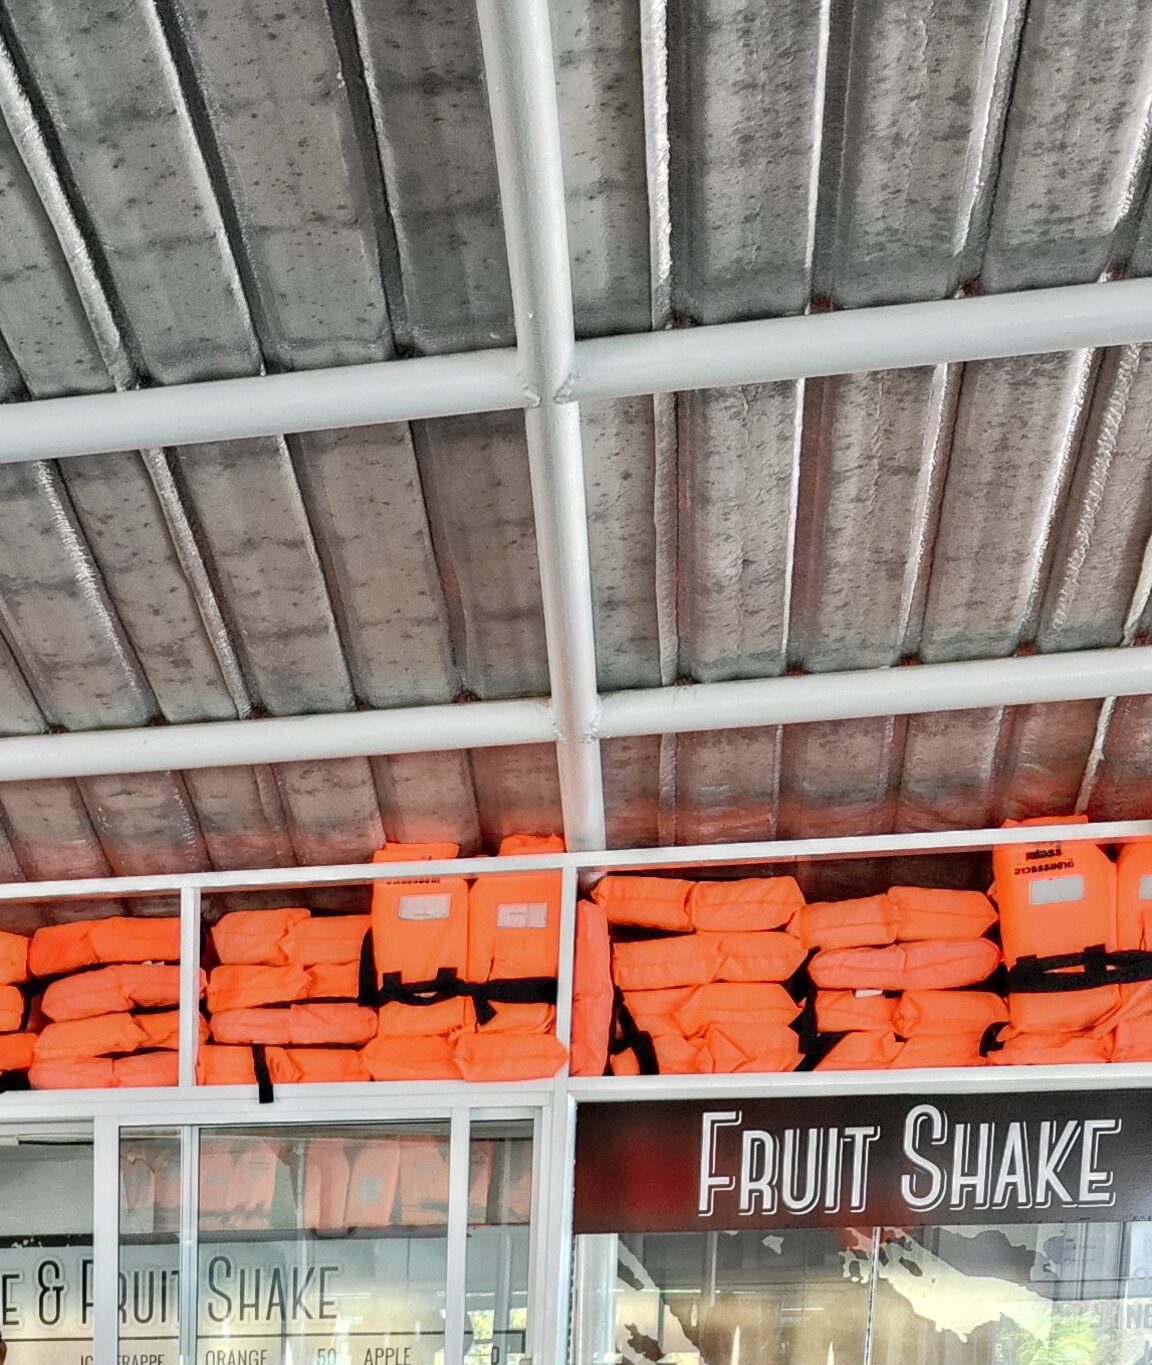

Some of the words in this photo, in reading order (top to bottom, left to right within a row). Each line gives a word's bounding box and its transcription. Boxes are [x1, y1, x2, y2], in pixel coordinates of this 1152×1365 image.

[697, 1110, 881, 1218] FRUIT
[901, 1103, 1123, 1211] SHAKE
[37, 1259, 65, 1326] &
[208, 1255, 340, 1323] SHAKE
